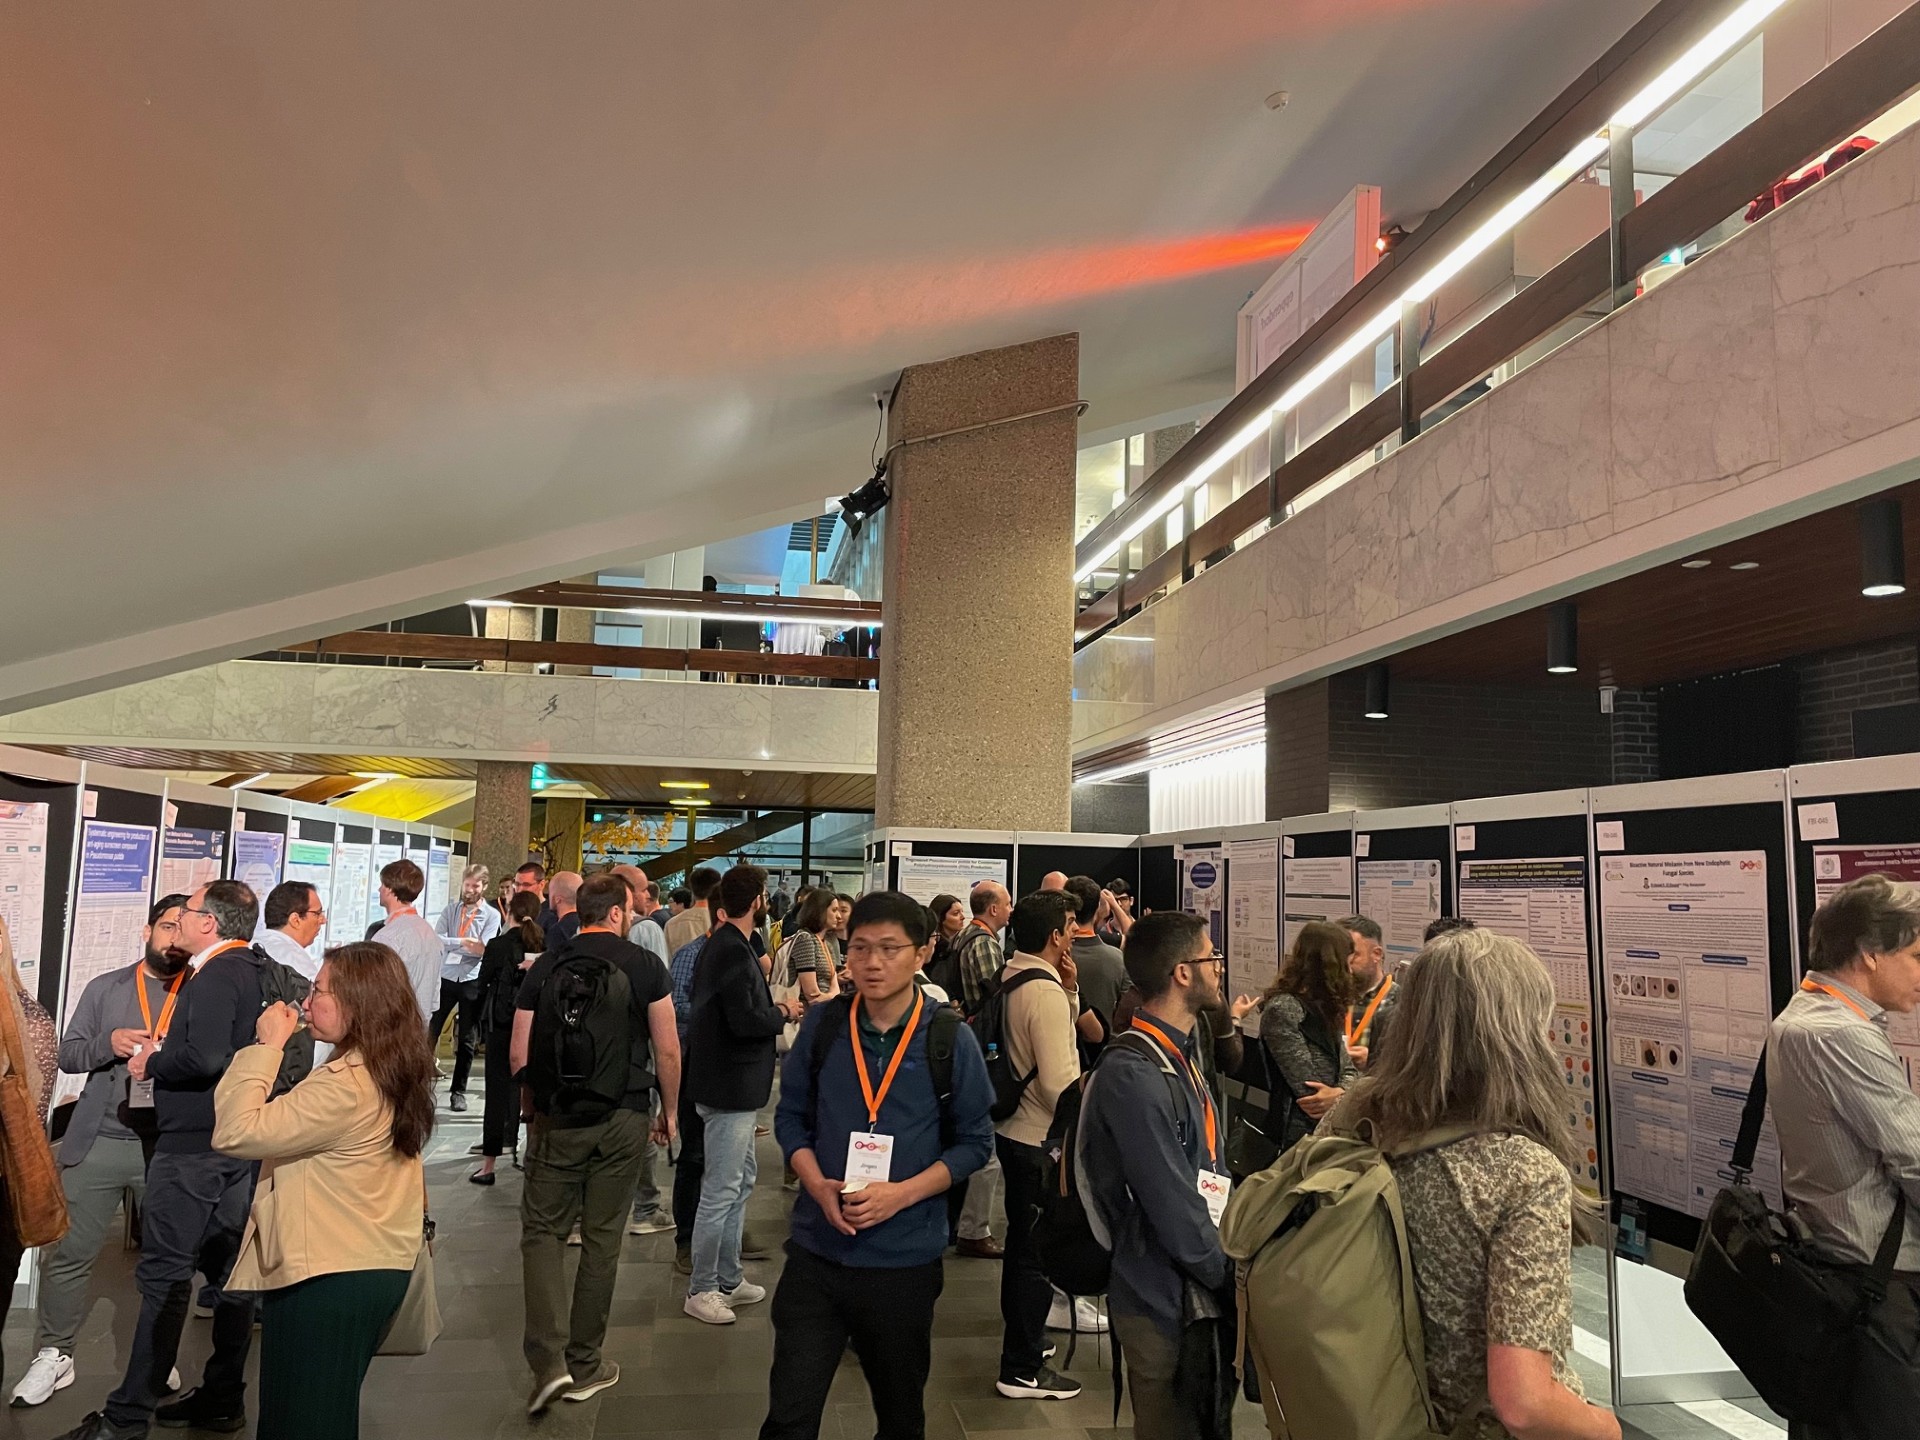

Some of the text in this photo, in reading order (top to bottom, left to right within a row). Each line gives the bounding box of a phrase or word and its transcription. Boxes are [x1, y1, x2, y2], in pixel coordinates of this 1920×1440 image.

[88, 828, 107, 838] Systematic
[107, 831, 126, 840] engineering
[1647, 860, 1663, 868] Natural
[1662, 869, 1678, 877] Fungal
